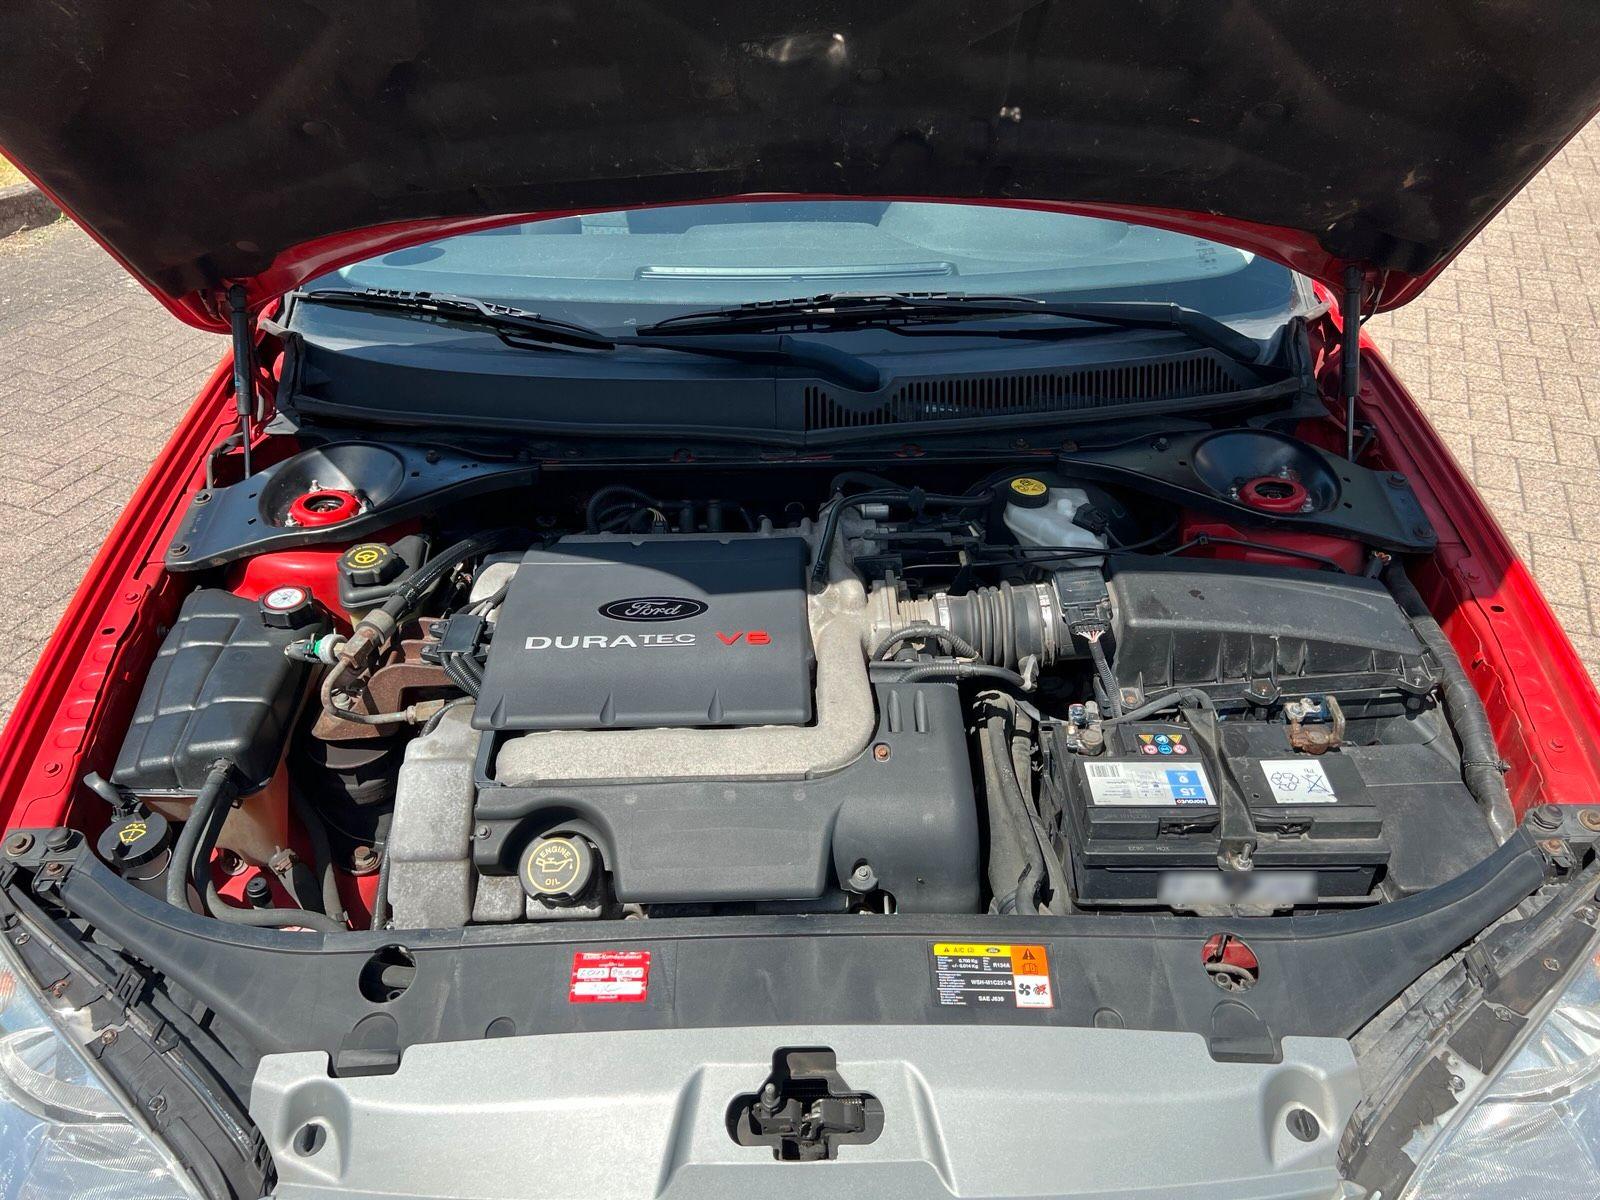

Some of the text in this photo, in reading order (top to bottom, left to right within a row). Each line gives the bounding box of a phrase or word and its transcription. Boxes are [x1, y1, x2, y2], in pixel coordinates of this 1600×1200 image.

[625, 601, 681, 616] Ford
[524, 630, 772, 650] DURATEC V6
[1180, 787, 1196, 796] 15
[540, 846, 571, 858] ENGINE
[545, 878, 561, 886] OIL
